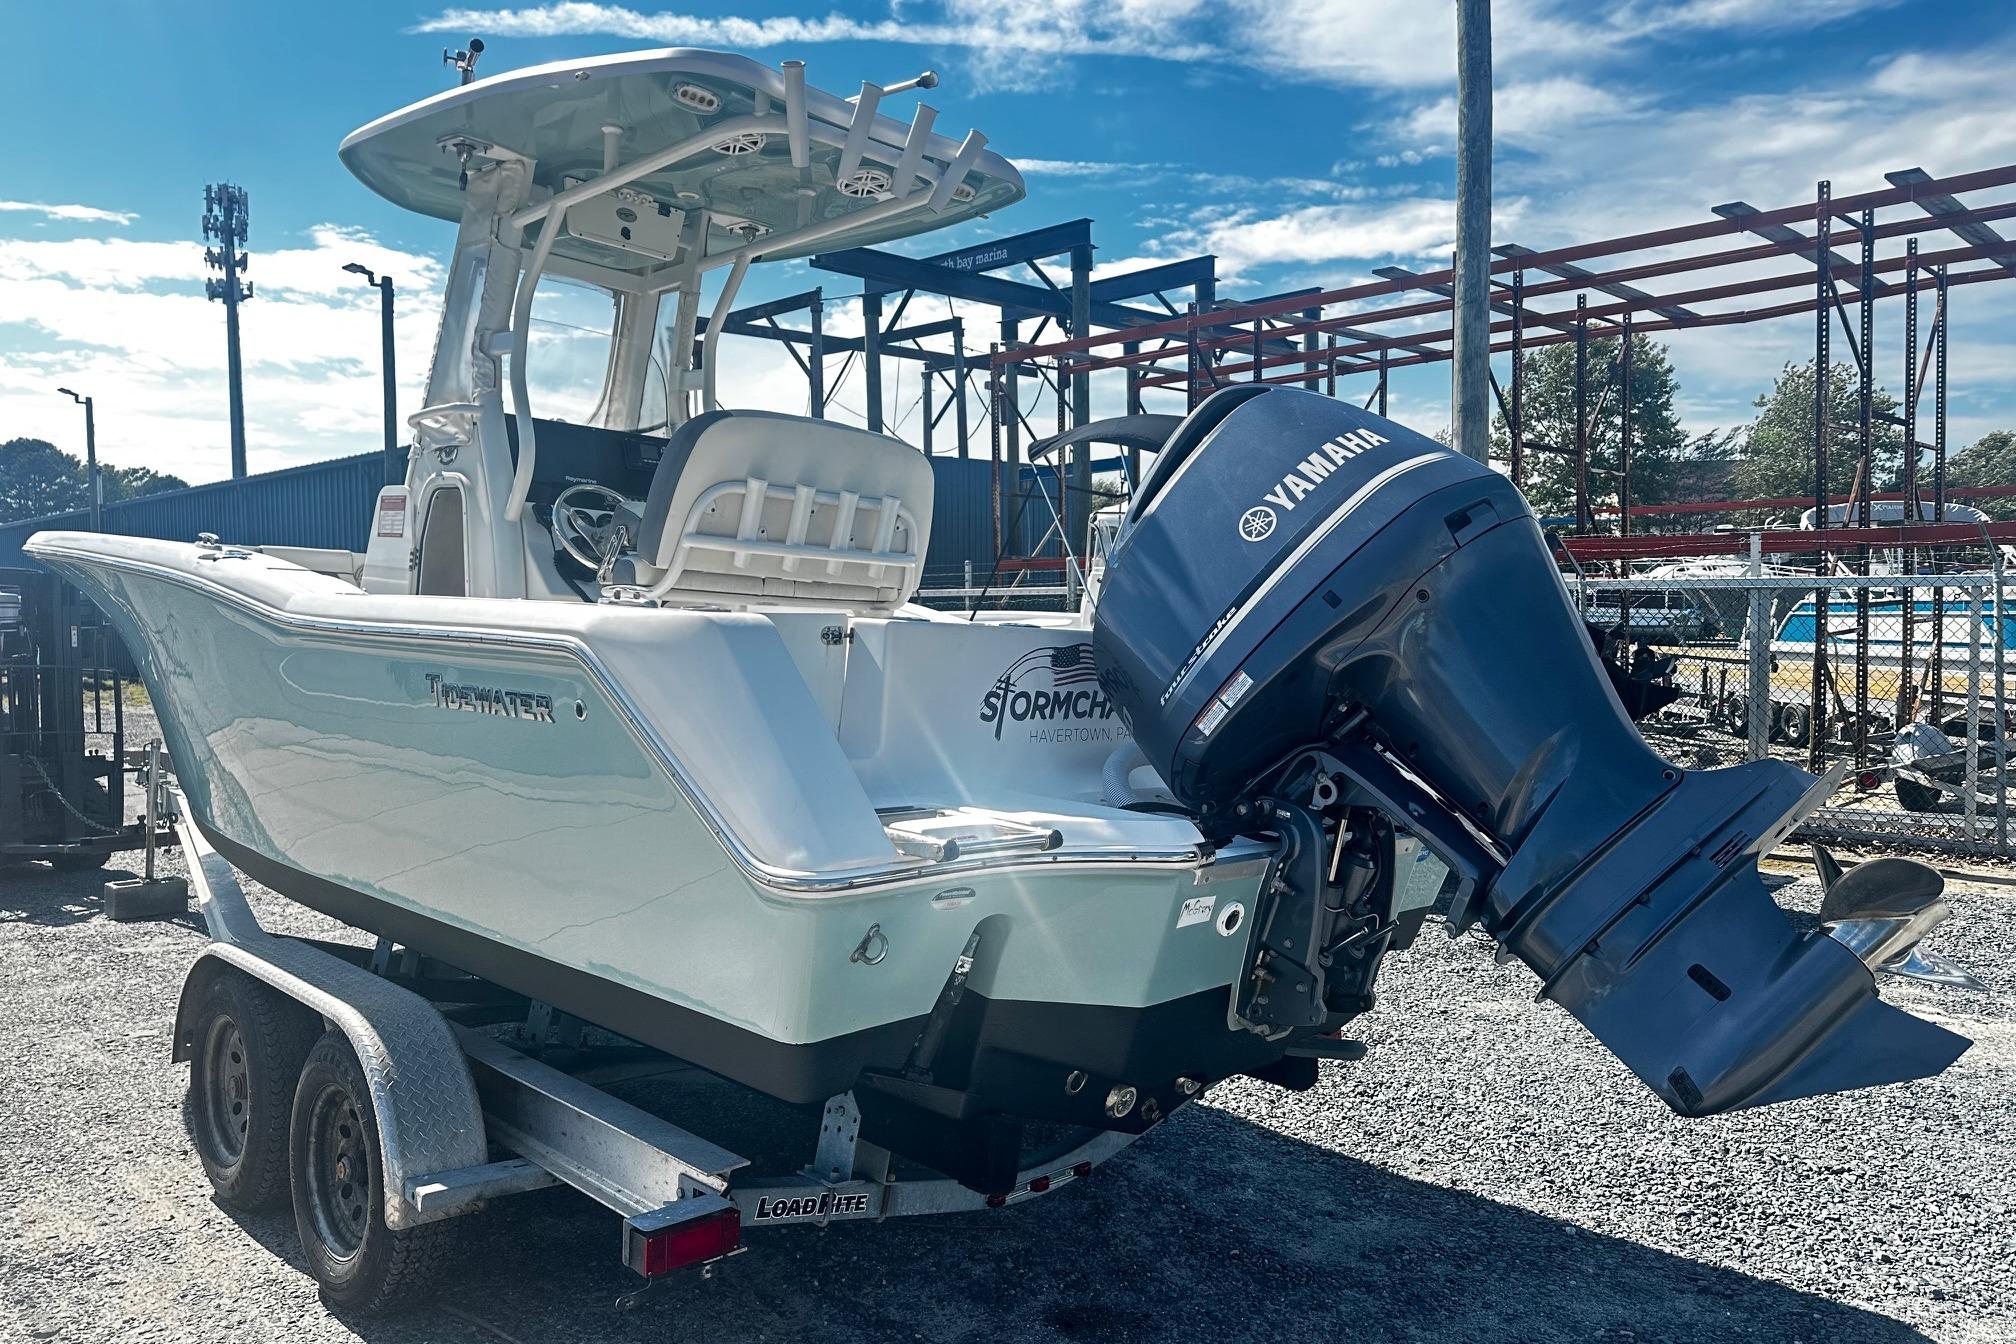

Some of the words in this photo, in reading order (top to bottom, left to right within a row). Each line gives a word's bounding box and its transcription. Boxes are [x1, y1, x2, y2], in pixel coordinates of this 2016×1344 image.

[956, 256, 974, 270] bay
[975, 247, 1008, 265] marina
[1263, 428, 1390, 511] YAMAHA
[426, 673, 556, 723] TIDEWATER
[1029, 728, 1113, 744] HAVERTOWN,
